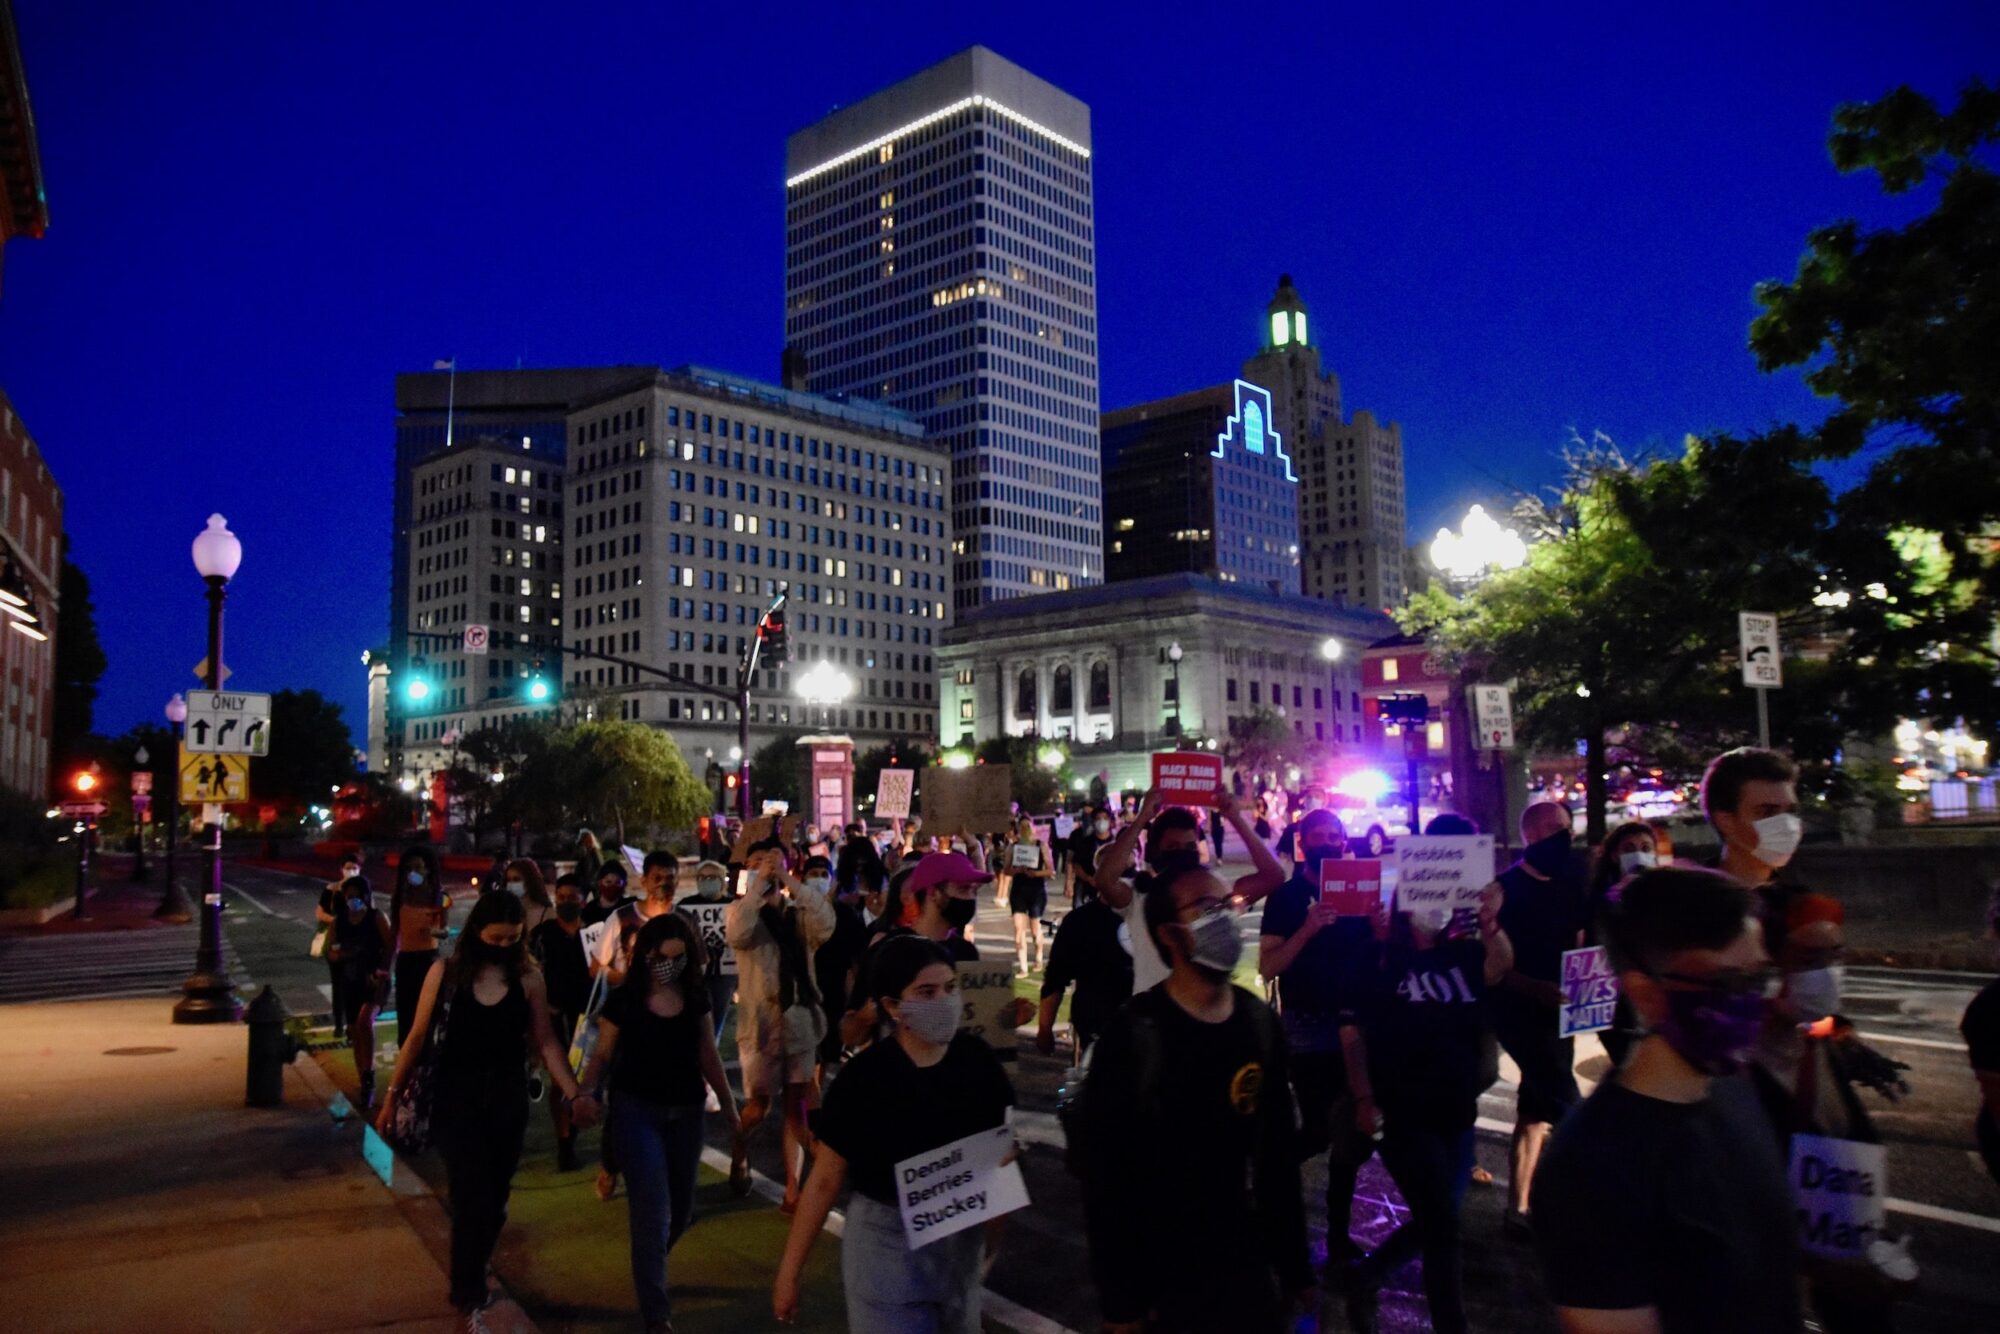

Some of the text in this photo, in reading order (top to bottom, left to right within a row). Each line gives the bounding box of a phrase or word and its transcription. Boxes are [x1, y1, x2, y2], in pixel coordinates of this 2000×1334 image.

[1746, 617, 1771, 632] STOP
[1757, 666, 1777, 680] RED
[1486, 690, 1500, 702] NO
[212, 697, 246, 711] ONLY
[1159, 764, 1186, 776] BLACK
[1159, 778, 1217, 792] LIVES MATTER
[1396, 966, 1477, 1004] 401
[1564, 1003, 1616, 1033] MATTE
[903, 1148, 963, 1184] Denali
[906, 1170, 973, 1207] Berries
[912, 1191, 987, 1231] Stuckey
